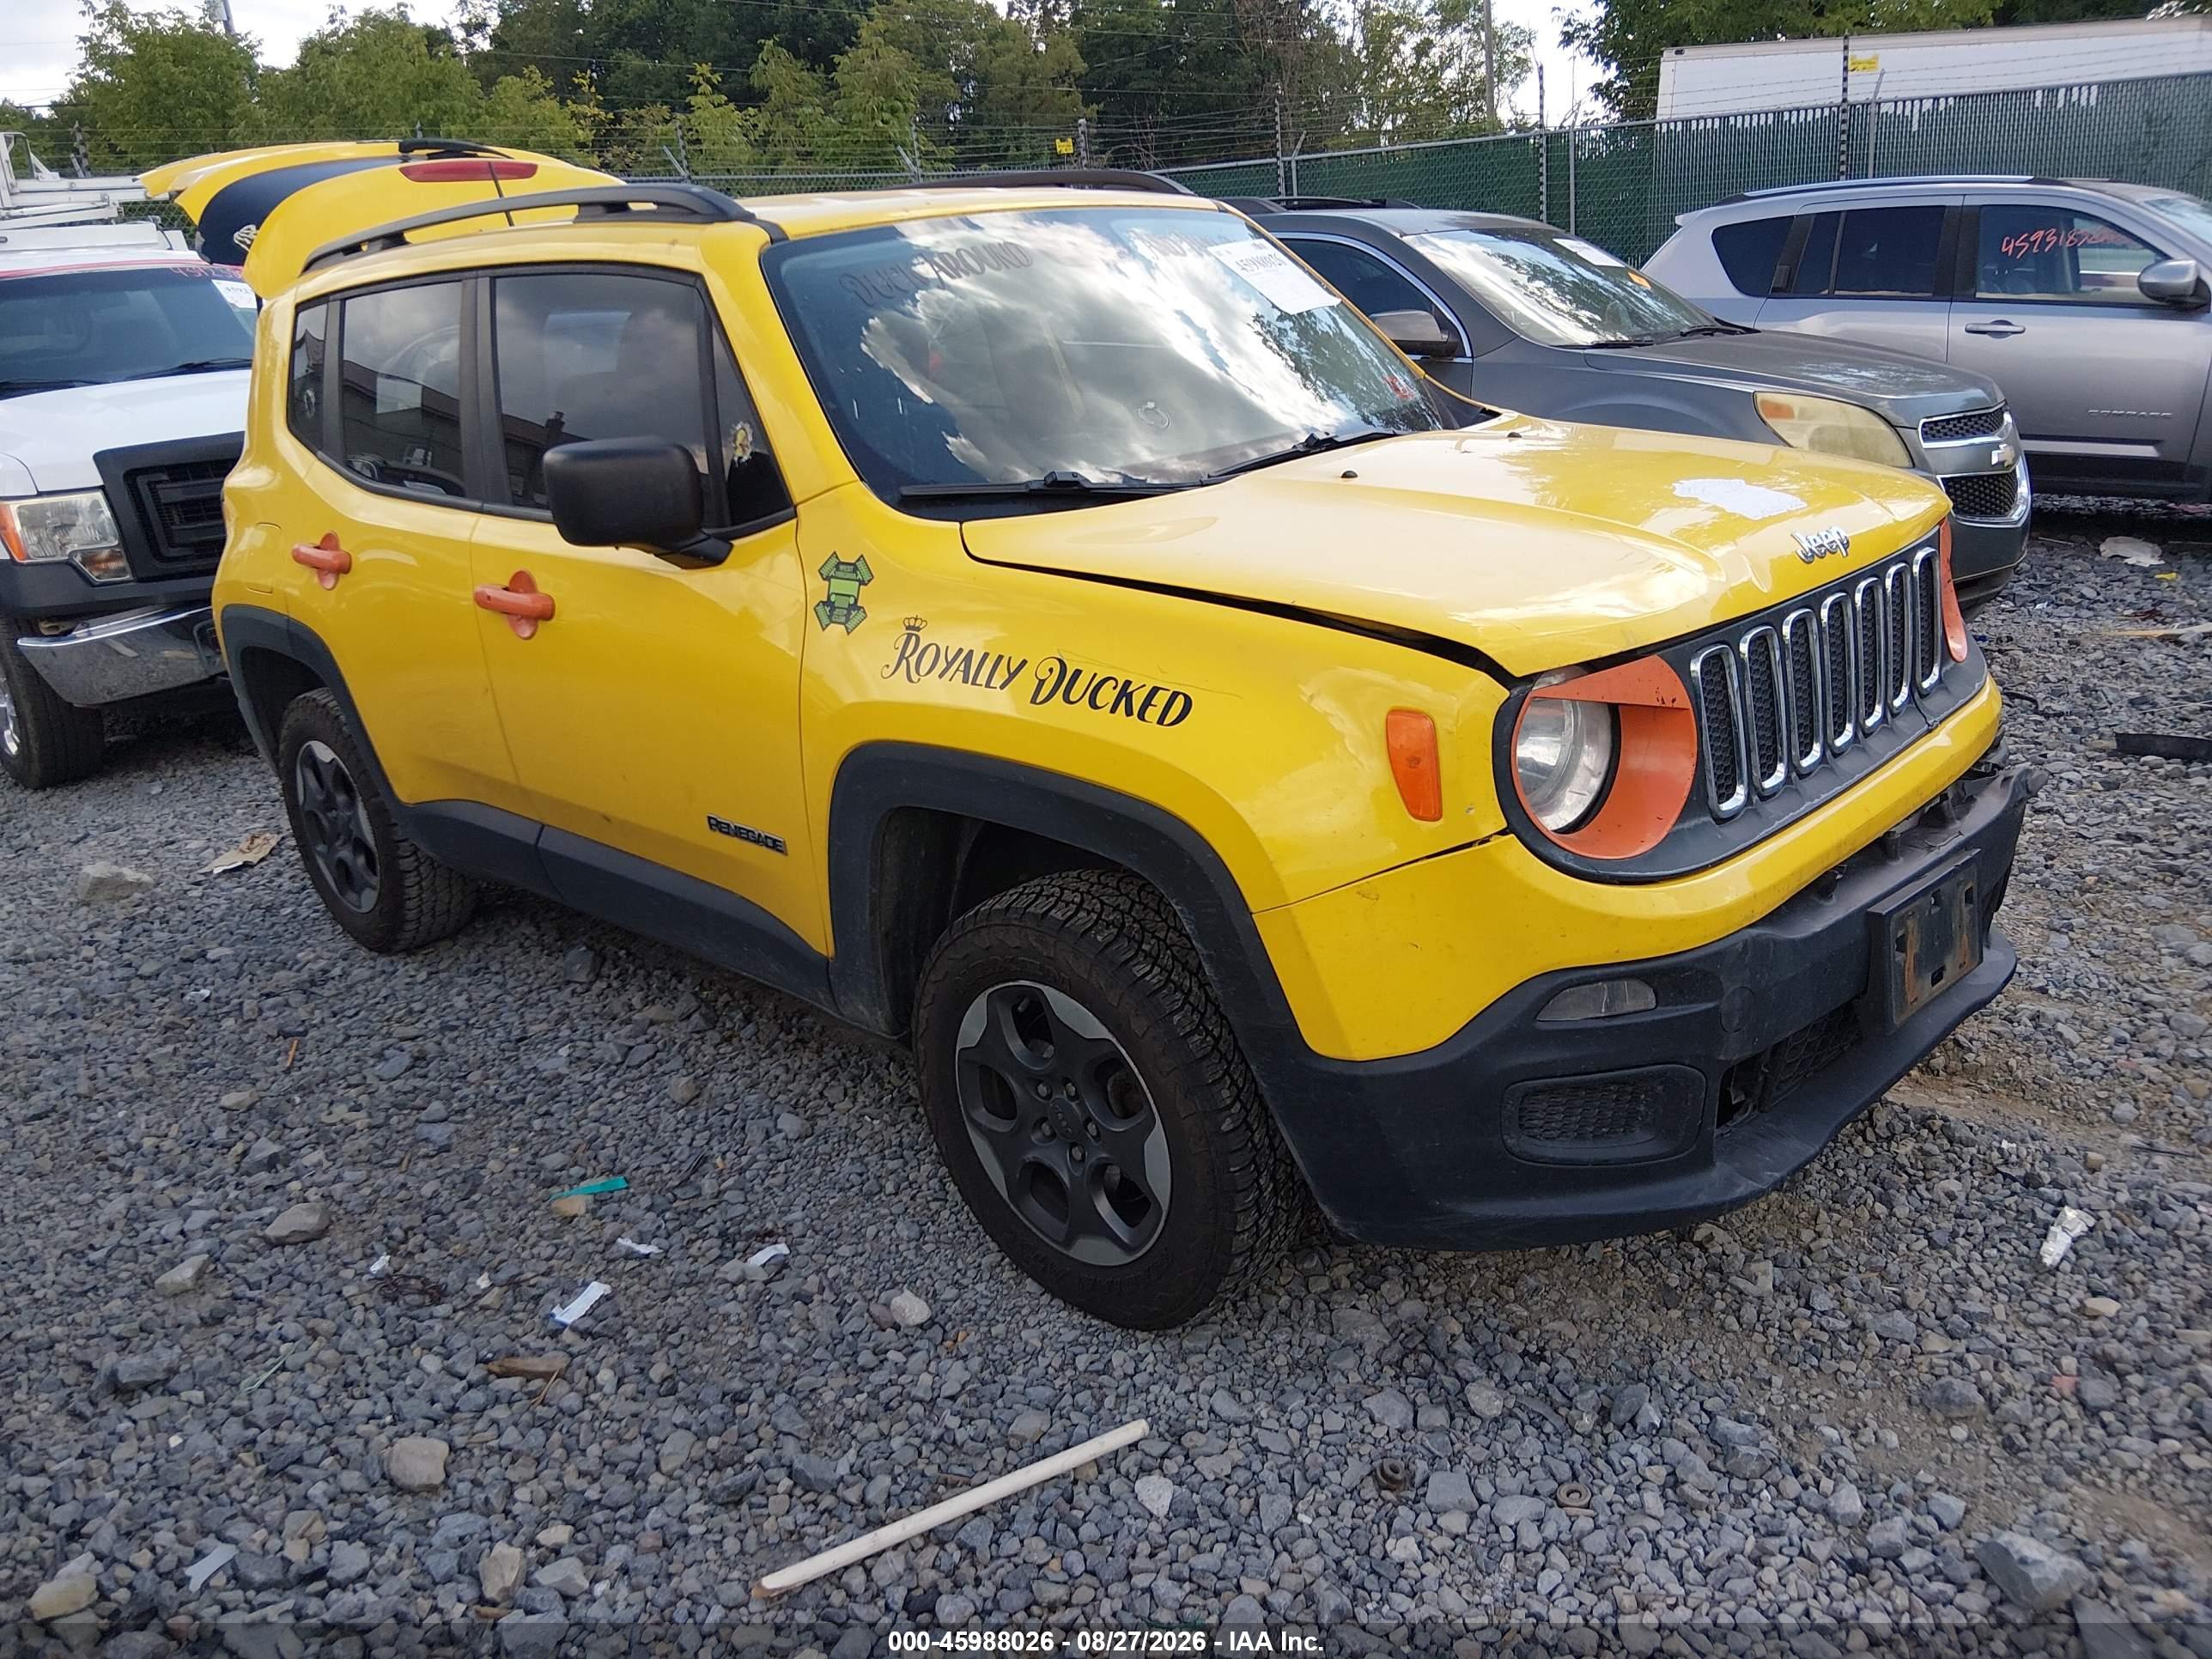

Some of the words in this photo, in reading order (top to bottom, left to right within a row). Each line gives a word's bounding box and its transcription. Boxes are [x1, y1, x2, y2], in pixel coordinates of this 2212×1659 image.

[922, 240, 1034, 290] AROUND
[1790, 526, 1850, 564] Jeep
[1030, 656, 1194, 727] DUCKED
[707, 812, 787, 855] RENEGADE
